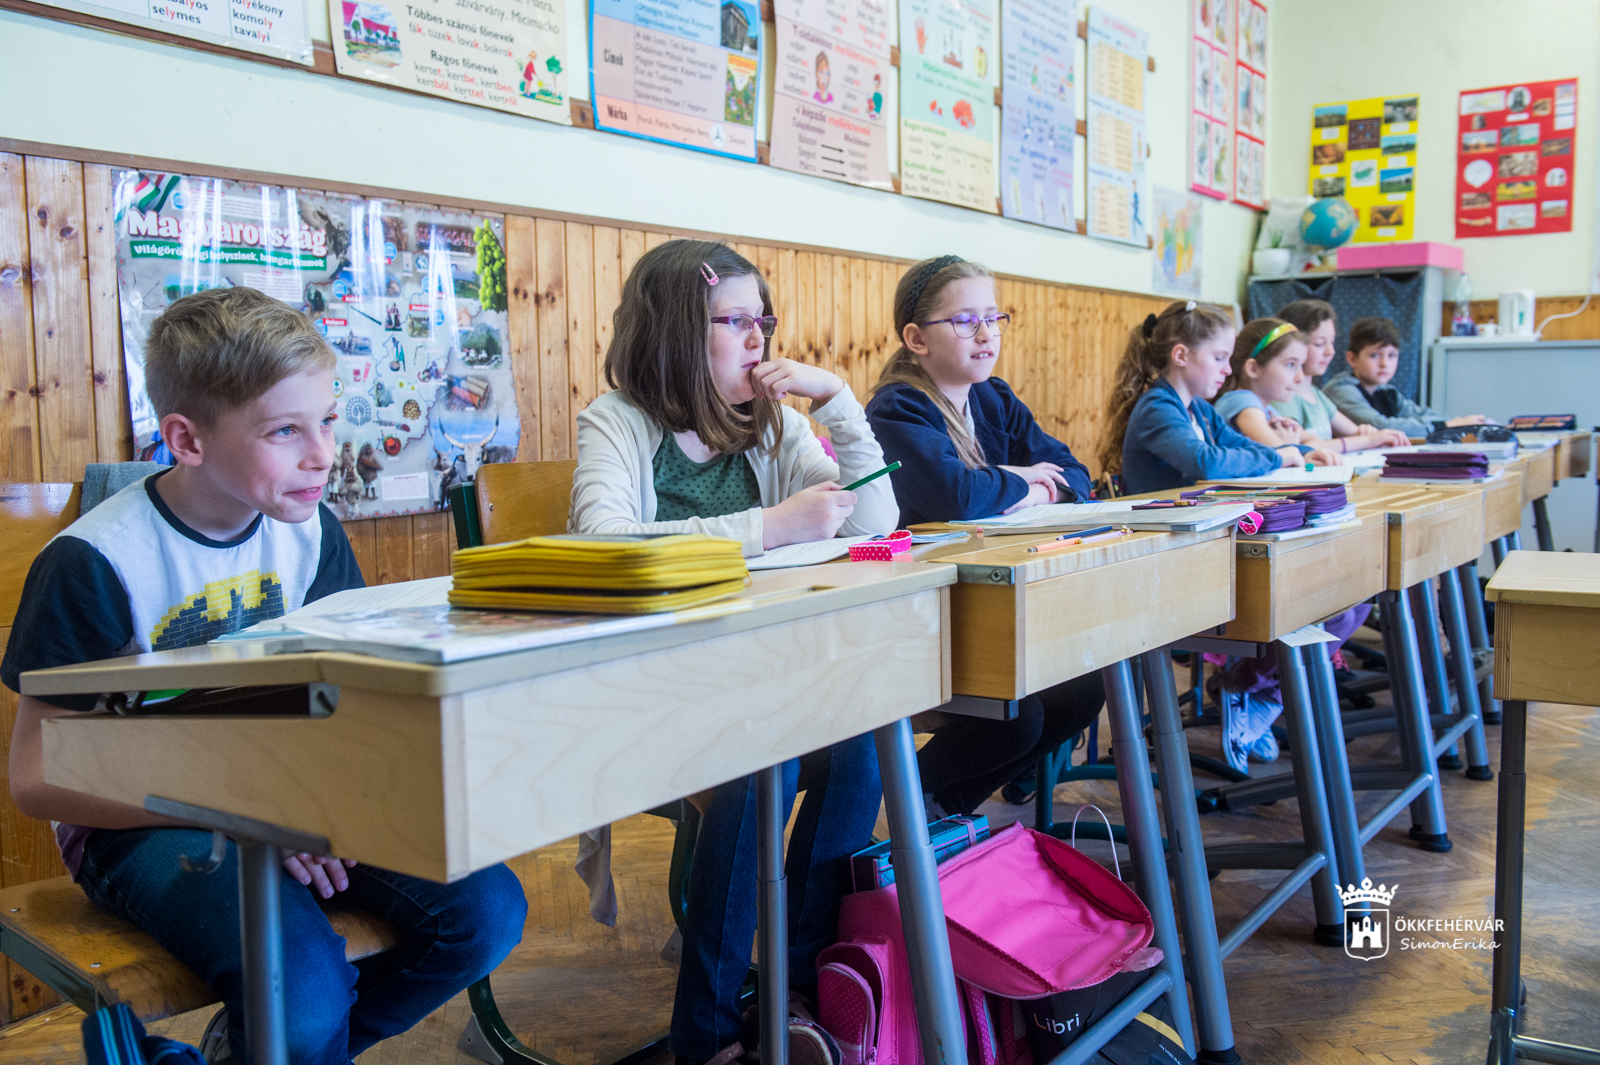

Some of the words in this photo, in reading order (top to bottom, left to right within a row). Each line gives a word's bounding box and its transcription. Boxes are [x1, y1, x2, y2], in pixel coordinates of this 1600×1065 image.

[152, 5, 201, 24] selymes
[232, 0, 283, 18] olyékony
[232, 8, 273, 30] komoly
[406, 4, 443, 24] Többes
[446, 18, 477, 33] számú
[479, 26, 515, 44] főnevek
[511, 9, 560, 34] Micimackó
[234, 25, 270, 42] tavalyi
[408, 21, 425, 36] fák,
[428, 28, 455, 43] tüzek,
[457, 34, 482, 51] lovak,
[484, 41, 514, 58] bokrok
[414, 60, 444, 78] kertet,
[446, 69, 478, 86] kertbe,
[430, 49, 459, 66] Ragos
[462, 58, 499, 76] főnevek
[606, 104, 628, 122] Márka
[127, 209, 328, 258] Magyarország
[209, 250, 259, 263] helyszínek,
[260, 253, 325, 268] hungarikumok
[1034, 1013, 1080, 1035] Libri
